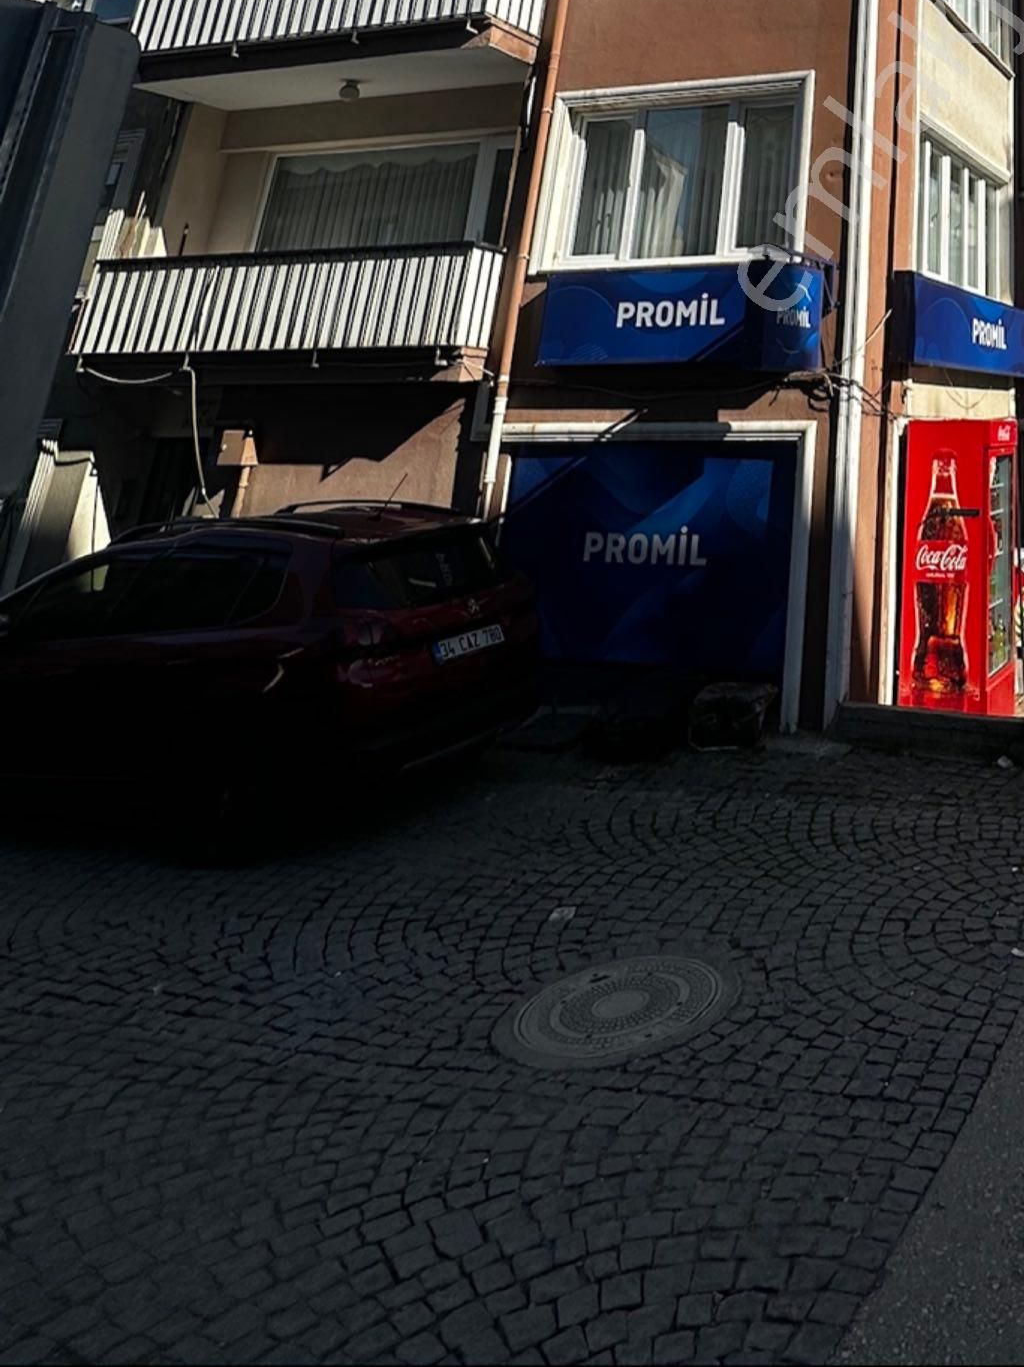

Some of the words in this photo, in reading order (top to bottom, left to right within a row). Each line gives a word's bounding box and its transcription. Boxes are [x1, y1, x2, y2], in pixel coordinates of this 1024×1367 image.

[616, 293, 725, 328] PROMİL
[776, 306, 811, 328] PROMİL
[972, 317, 1008, 350] PROMİL
[583, 525, 707, 566] PROMİL
[916, 544, 968, 571] Coca-Cola
[440, 641, 455, 658] 34
[459, 633, 480, 651] CAZ
